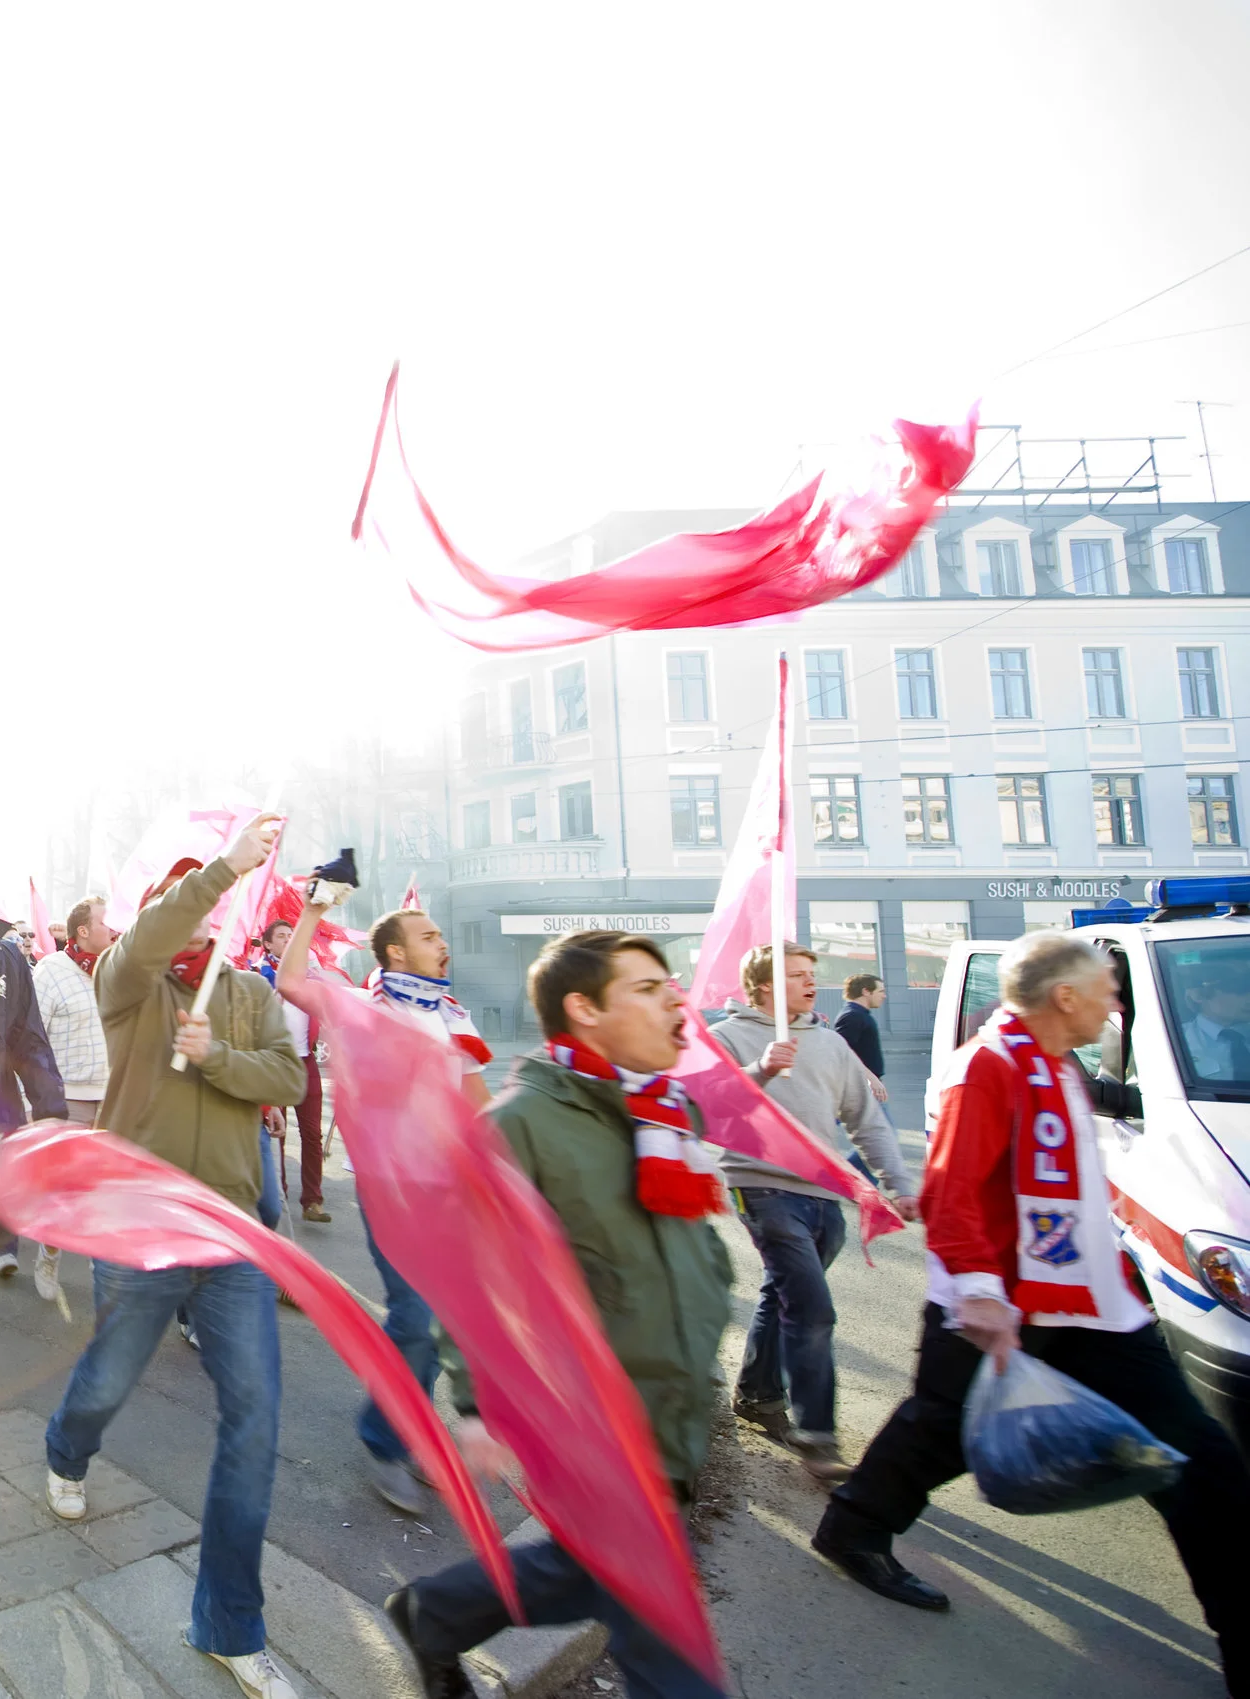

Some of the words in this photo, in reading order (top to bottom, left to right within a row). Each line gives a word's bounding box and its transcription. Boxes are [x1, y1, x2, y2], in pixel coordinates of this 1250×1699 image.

[988, 882, 1029, 898] SUSHI
[1036, 882, 1047, 898] &
[1054, 882, 1120, 898] NOODLES
[543, 917, 584, 931] SUSHI
[590, 917, 600, 931] &
[606, 916, 670, 931] NOODLES
